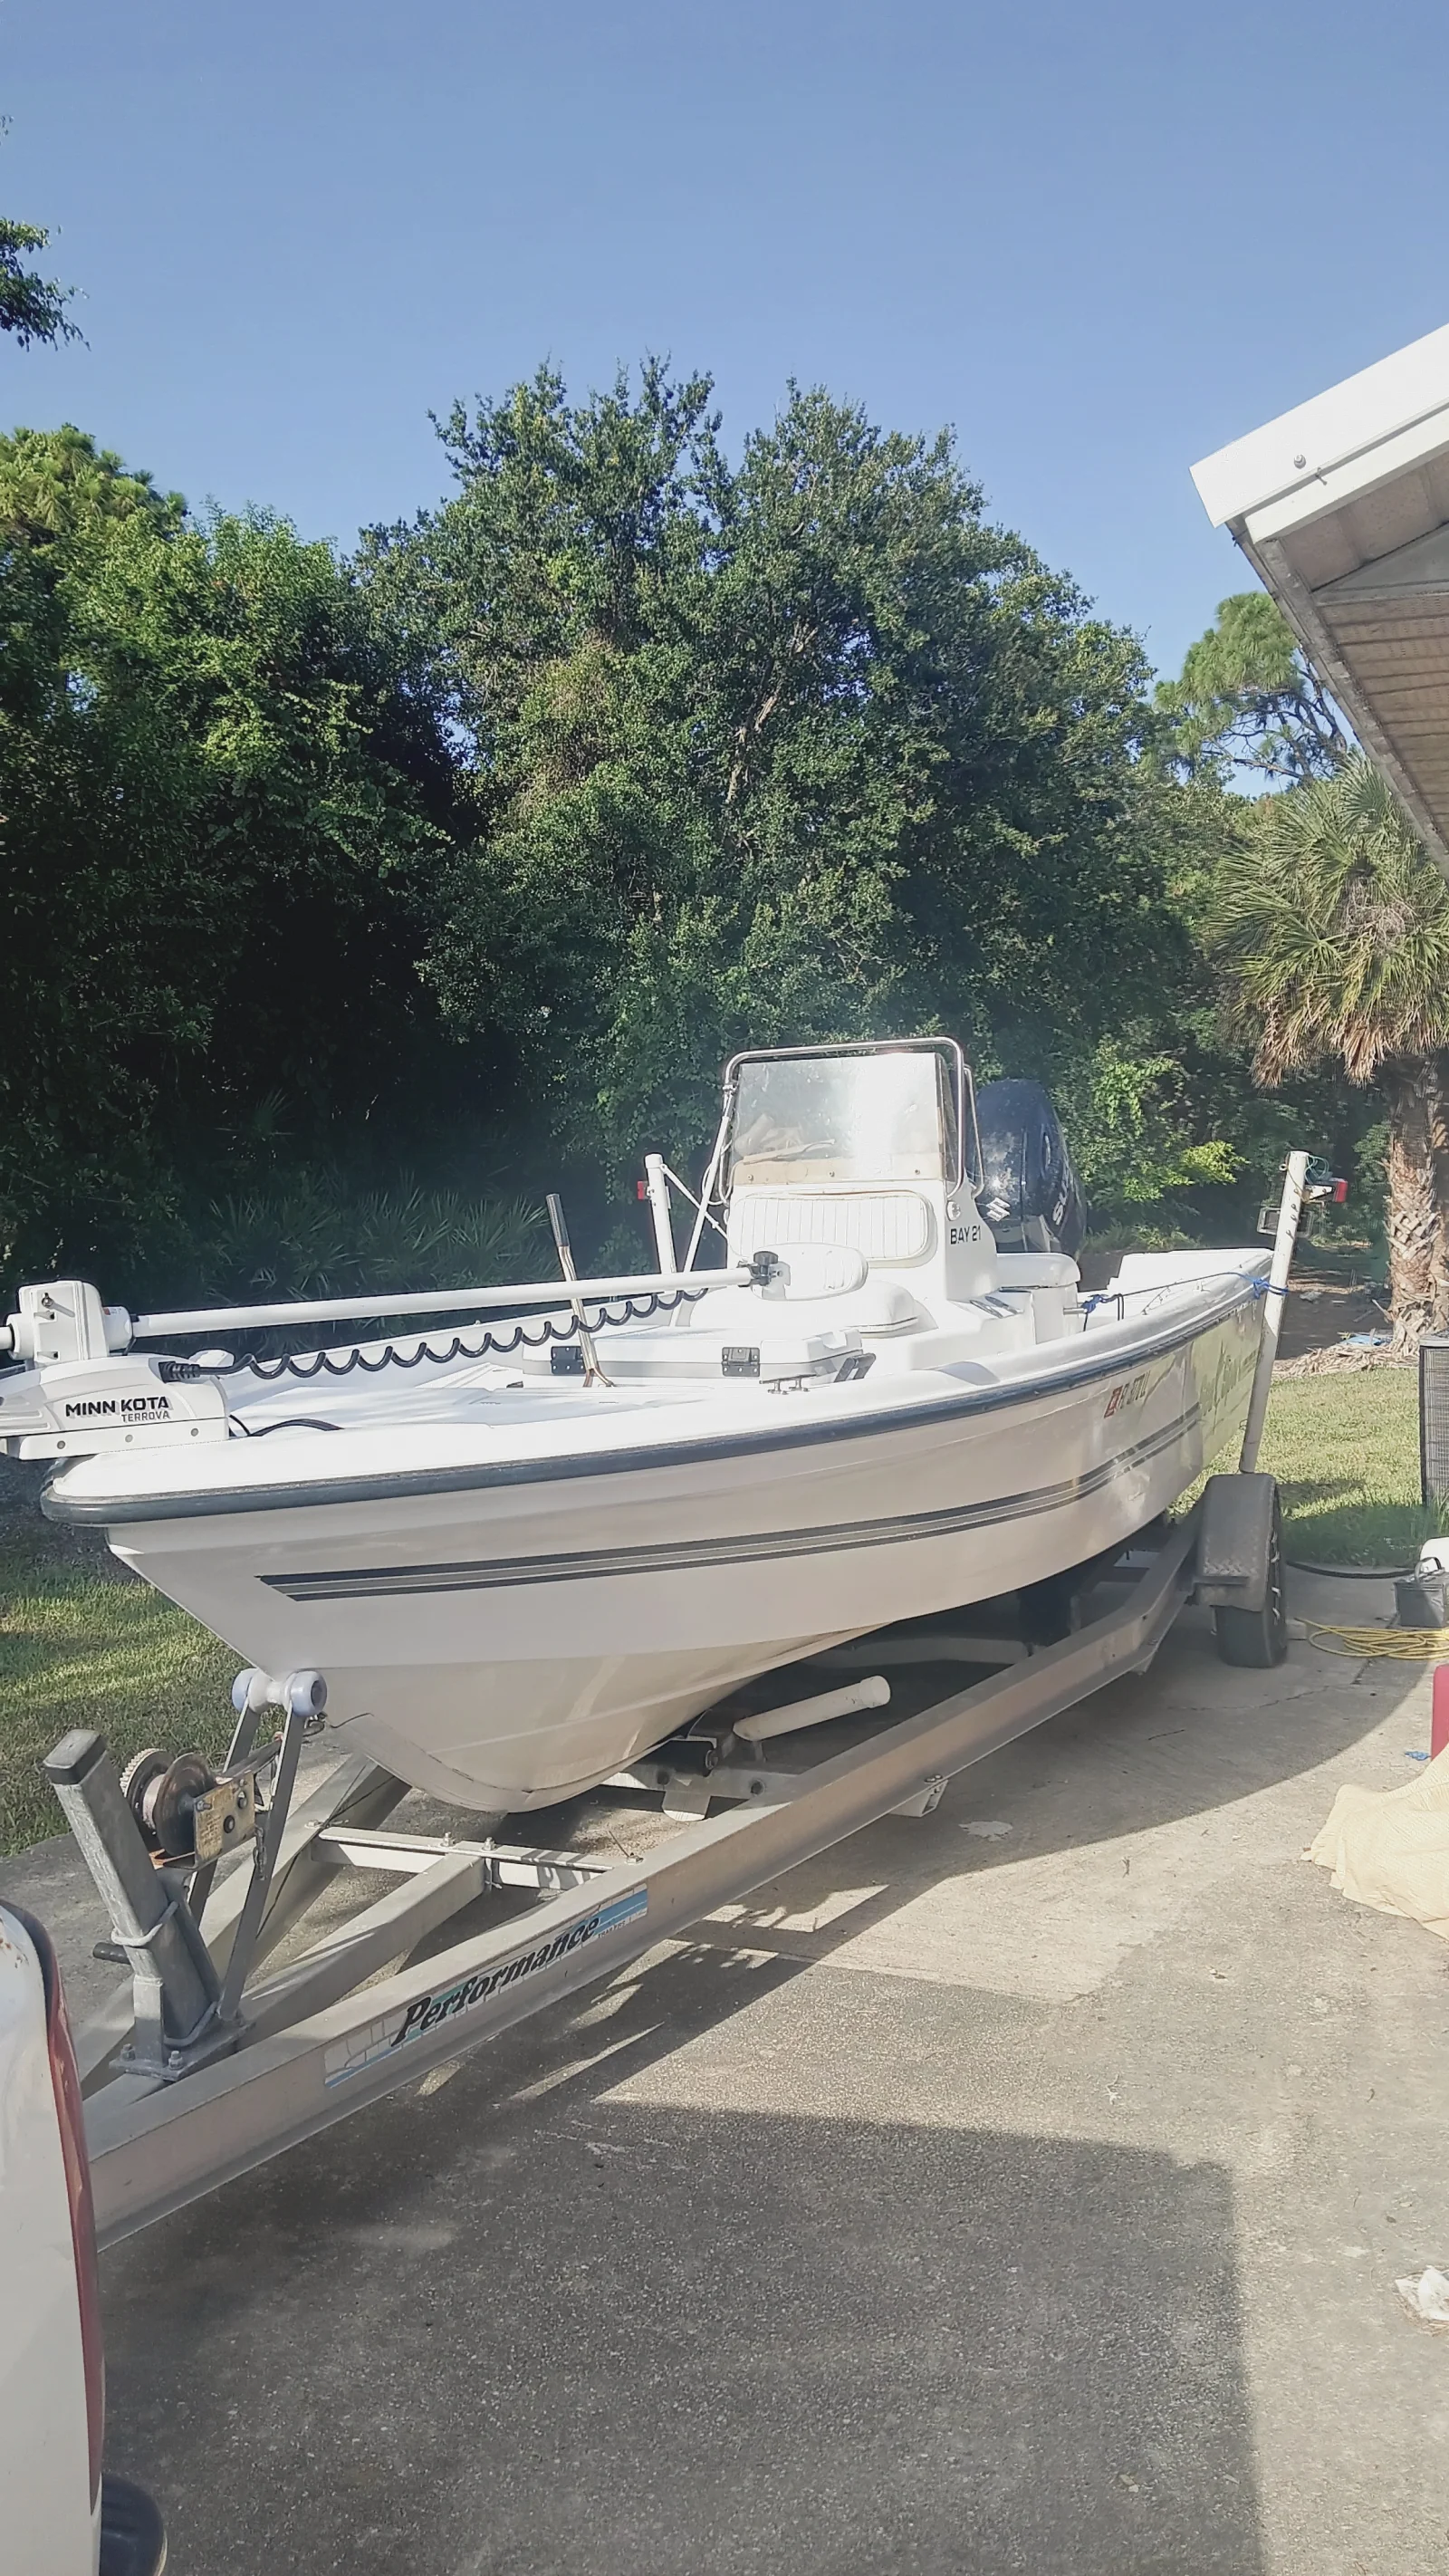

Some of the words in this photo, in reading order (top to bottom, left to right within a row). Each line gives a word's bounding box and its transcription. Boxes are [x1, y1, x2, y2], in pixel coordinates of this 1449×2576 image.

[950, 1226, 970, 1245] BAY
[972, 1225, 982, 1242] 21
[65, 1399, 116, 1418] MINN
[120, 1396, 169, 1412] KOTA
[120, 1410, 170, 1423] TERROVA
[390, 1916, 600, 2047] Performance
